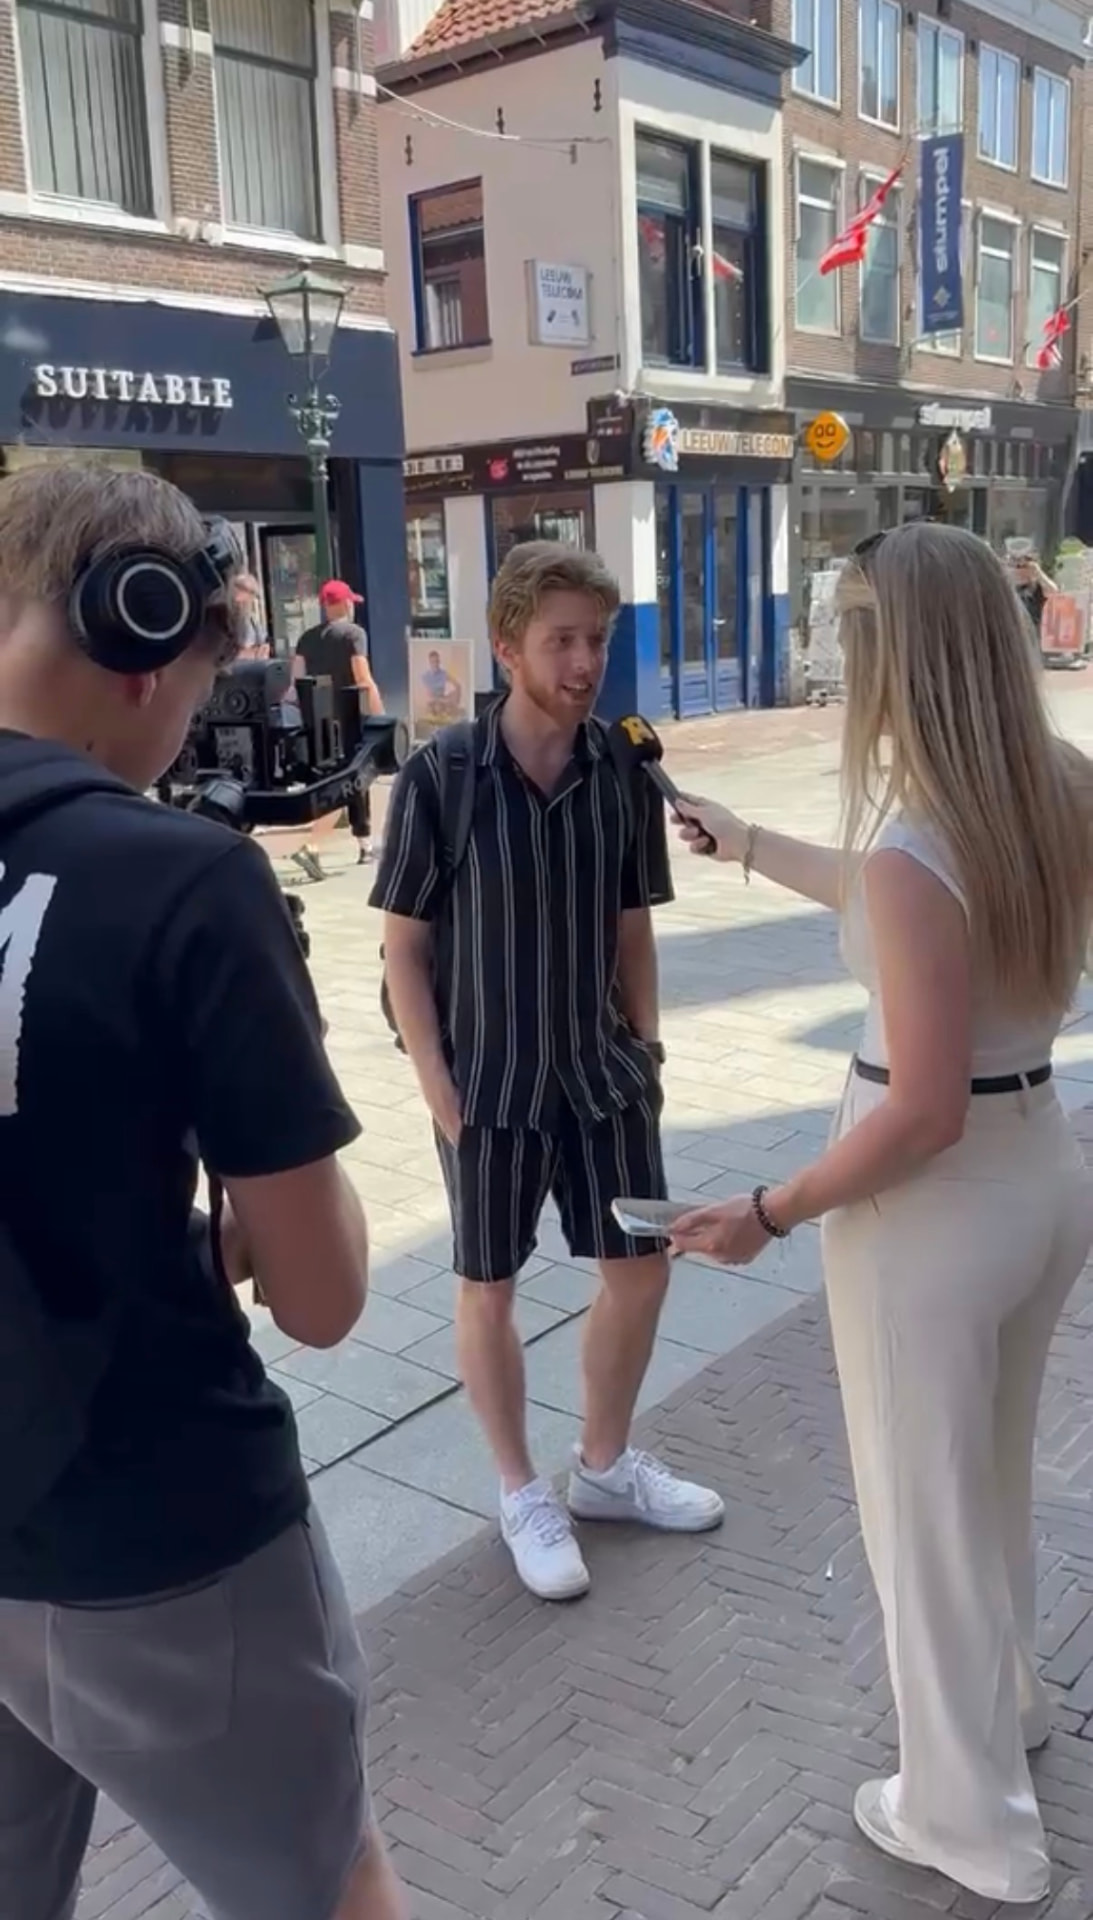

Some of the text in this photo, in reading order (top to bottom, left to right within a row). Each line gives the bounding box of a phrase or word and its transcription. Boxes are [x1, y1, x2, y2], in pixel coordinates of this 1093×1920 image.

[933, 147, 950, 273] stumpel
[540, 268, 572, 284] LEEUW
[541, 283, 583, 299] TELECOM
[35, 364, 233, 408] SUITABLE
[682, 428, 793, 457] LEEUW TELECOM
